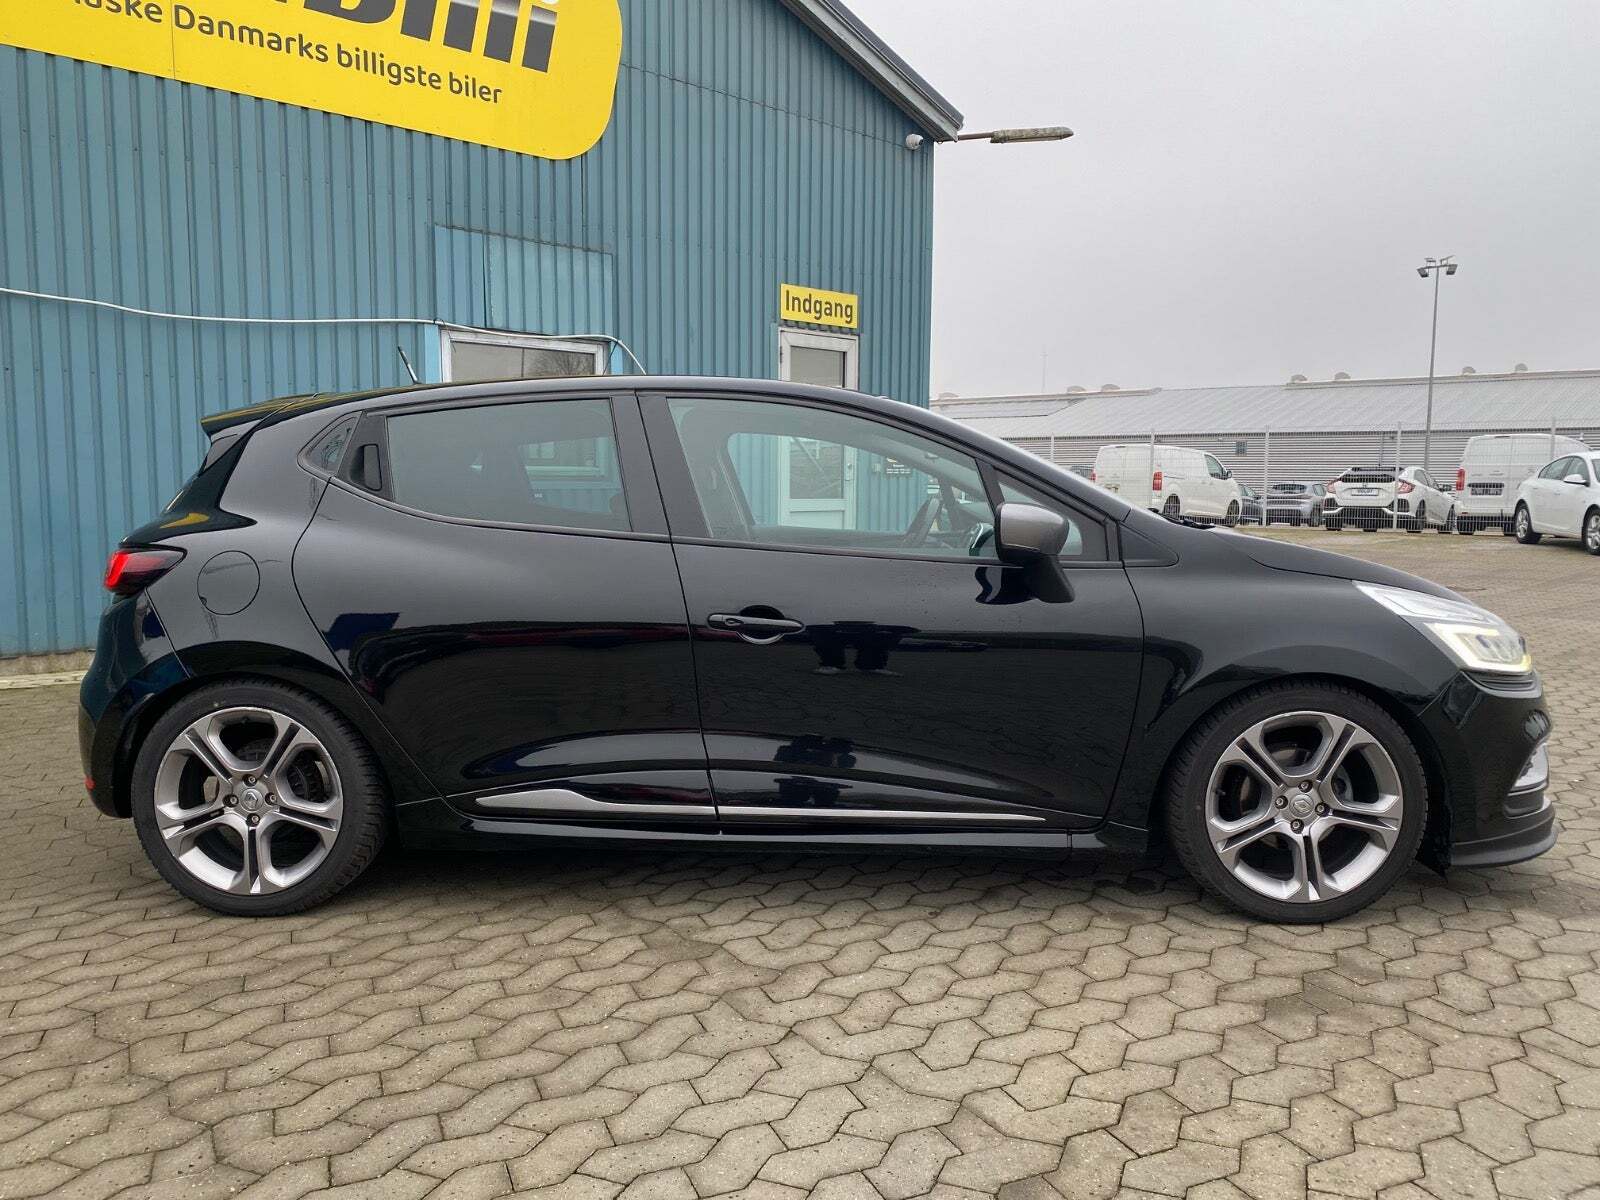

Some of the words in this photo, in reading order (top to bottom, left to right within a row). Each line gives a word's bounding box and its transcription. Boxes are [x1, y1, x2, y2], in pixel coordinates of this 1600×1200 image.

[174, 4, 329, 63] Danmarks
[336, 43, 442, 90] billigste
[449, 71, 502, 104] biler
[785, 289, 854, 324] Indgang
